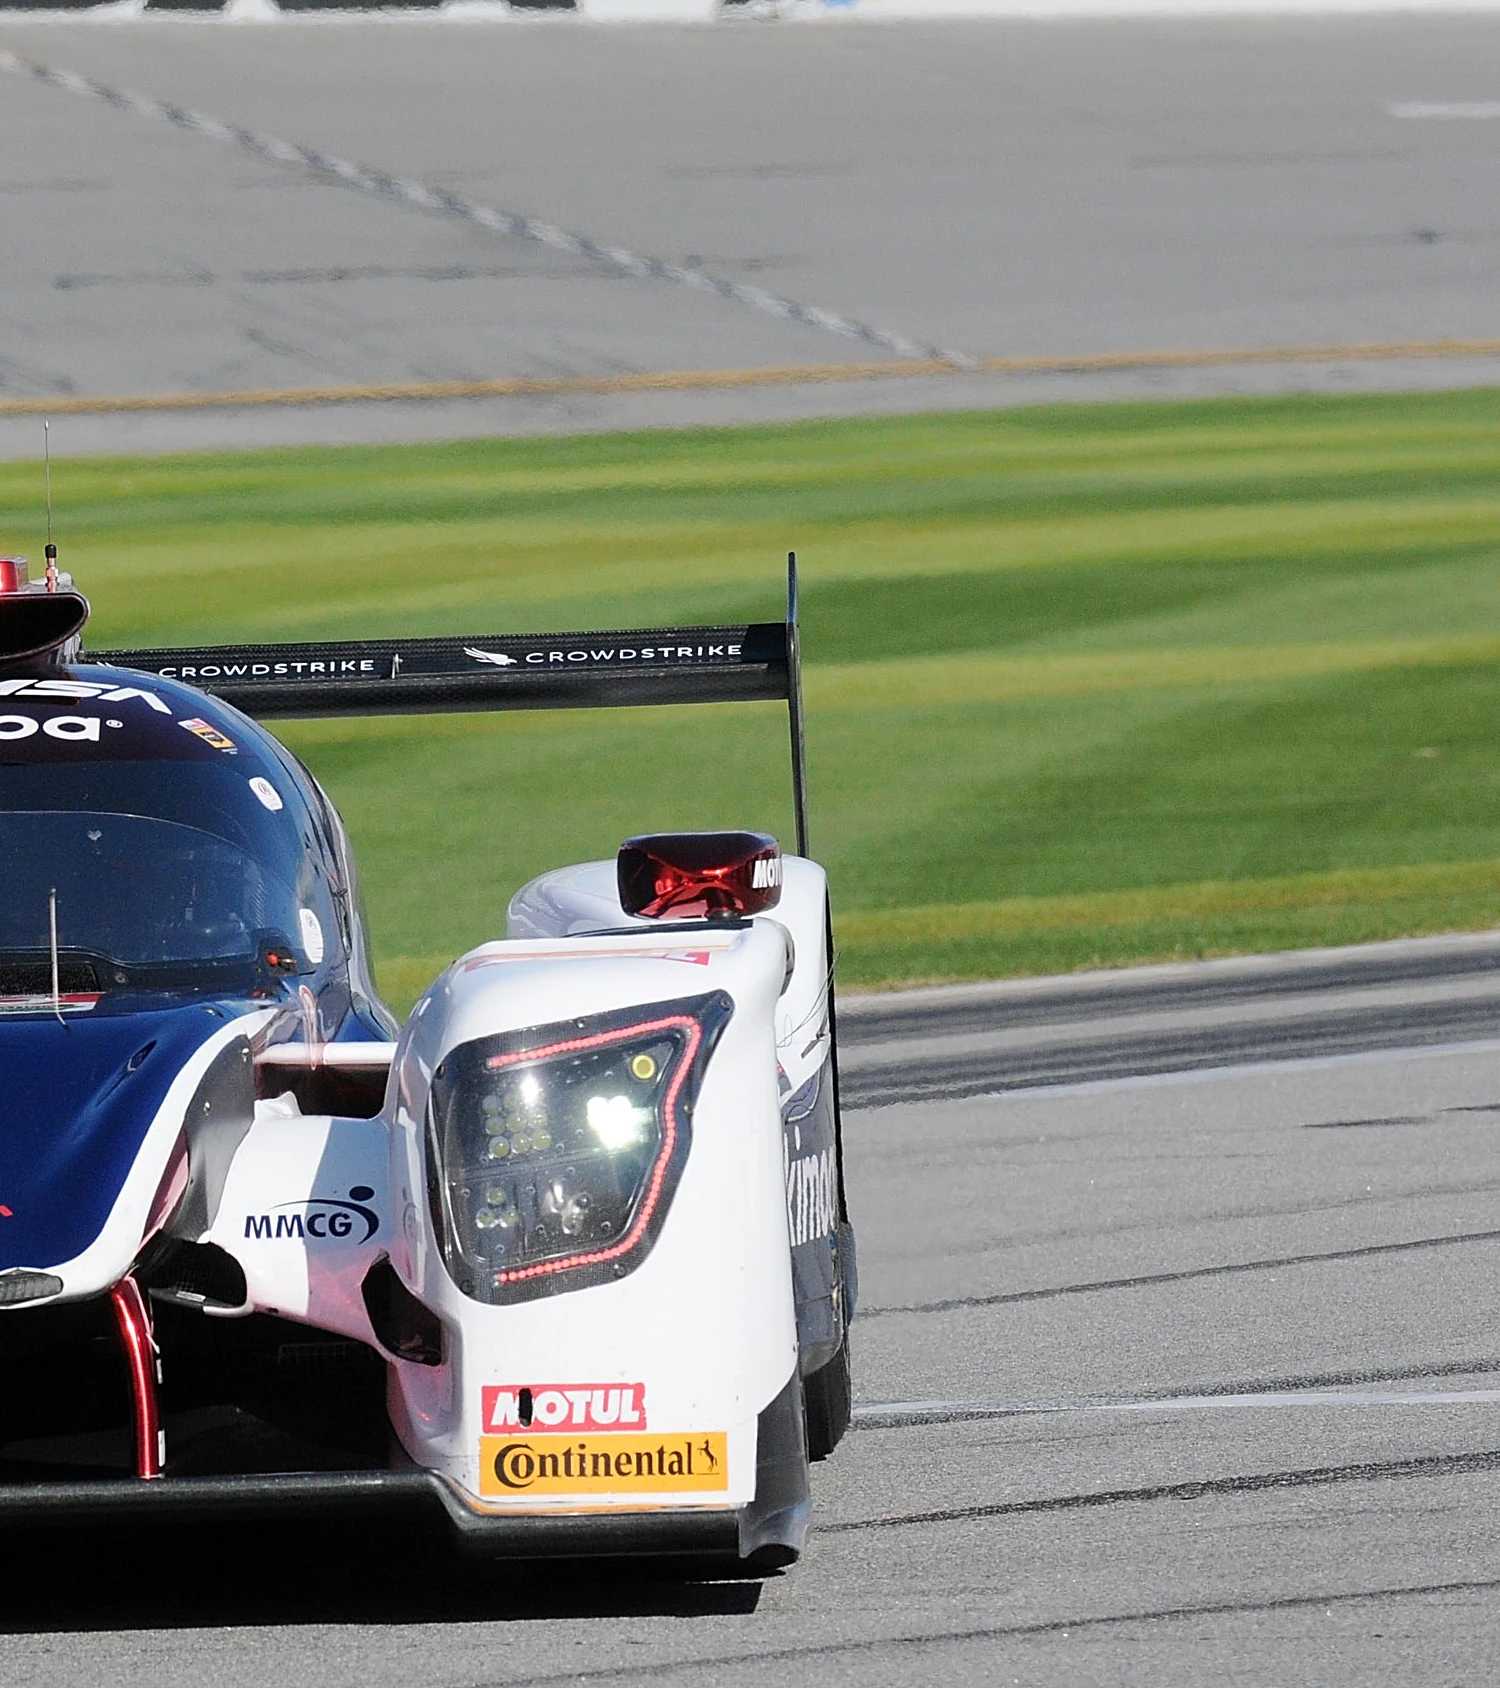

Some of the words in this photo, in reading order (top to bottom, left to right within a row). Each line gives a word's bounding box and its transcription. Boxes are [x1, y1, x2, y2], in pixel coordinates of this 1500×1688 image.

[525, 644, 742, 663] CROWDSTRIKE
[159, 659, 375, 679] CROWDSTRIKE
[243, 1212, 353, 1239] MMCG
[490, 1388, 641, 1427] MOTUL
[493, 1442, 694, 1489] Continental
